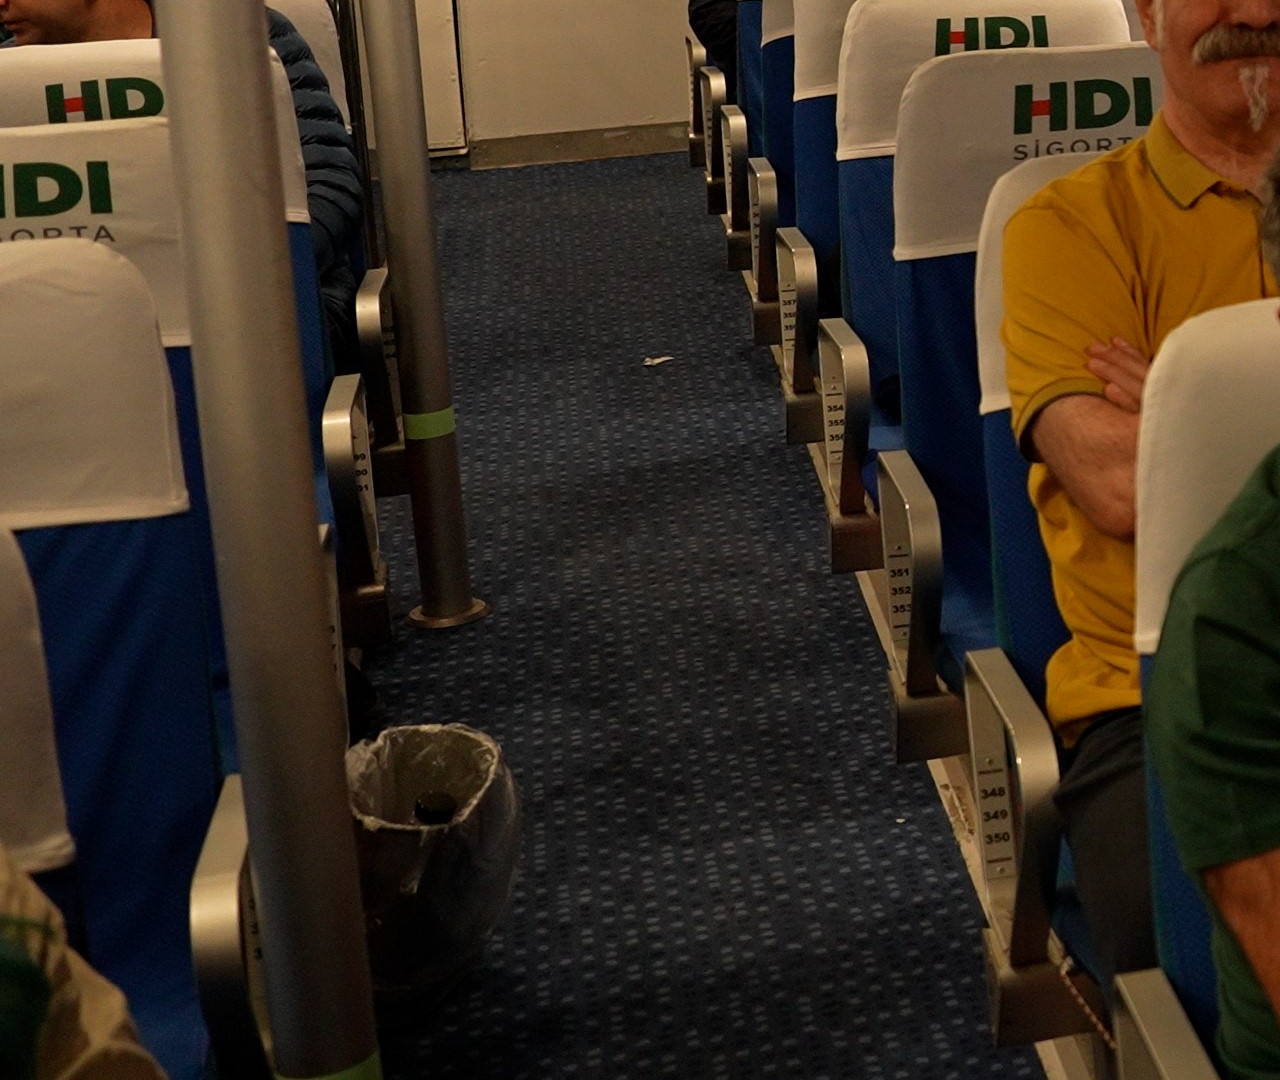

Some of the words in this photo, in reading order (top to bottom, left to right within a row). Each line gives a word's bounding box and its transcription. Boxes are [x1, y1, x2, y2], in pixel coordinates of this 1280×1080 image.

[935, 15, 1049, 56] HDI
[45, 76, 165, 124] HD
[1014, 77, 1153, 135] HDI
[1014, 137, 1133, 161] SİGORT
[0, 160, 113, 218] DI
[890, 569, 909, 578] 351
[891, 586, 911, 595] 352
[981, 786, 1006, 799] 348
[983, 809, 1008, 821] 349
[985, 831, 1011, 845] 350
